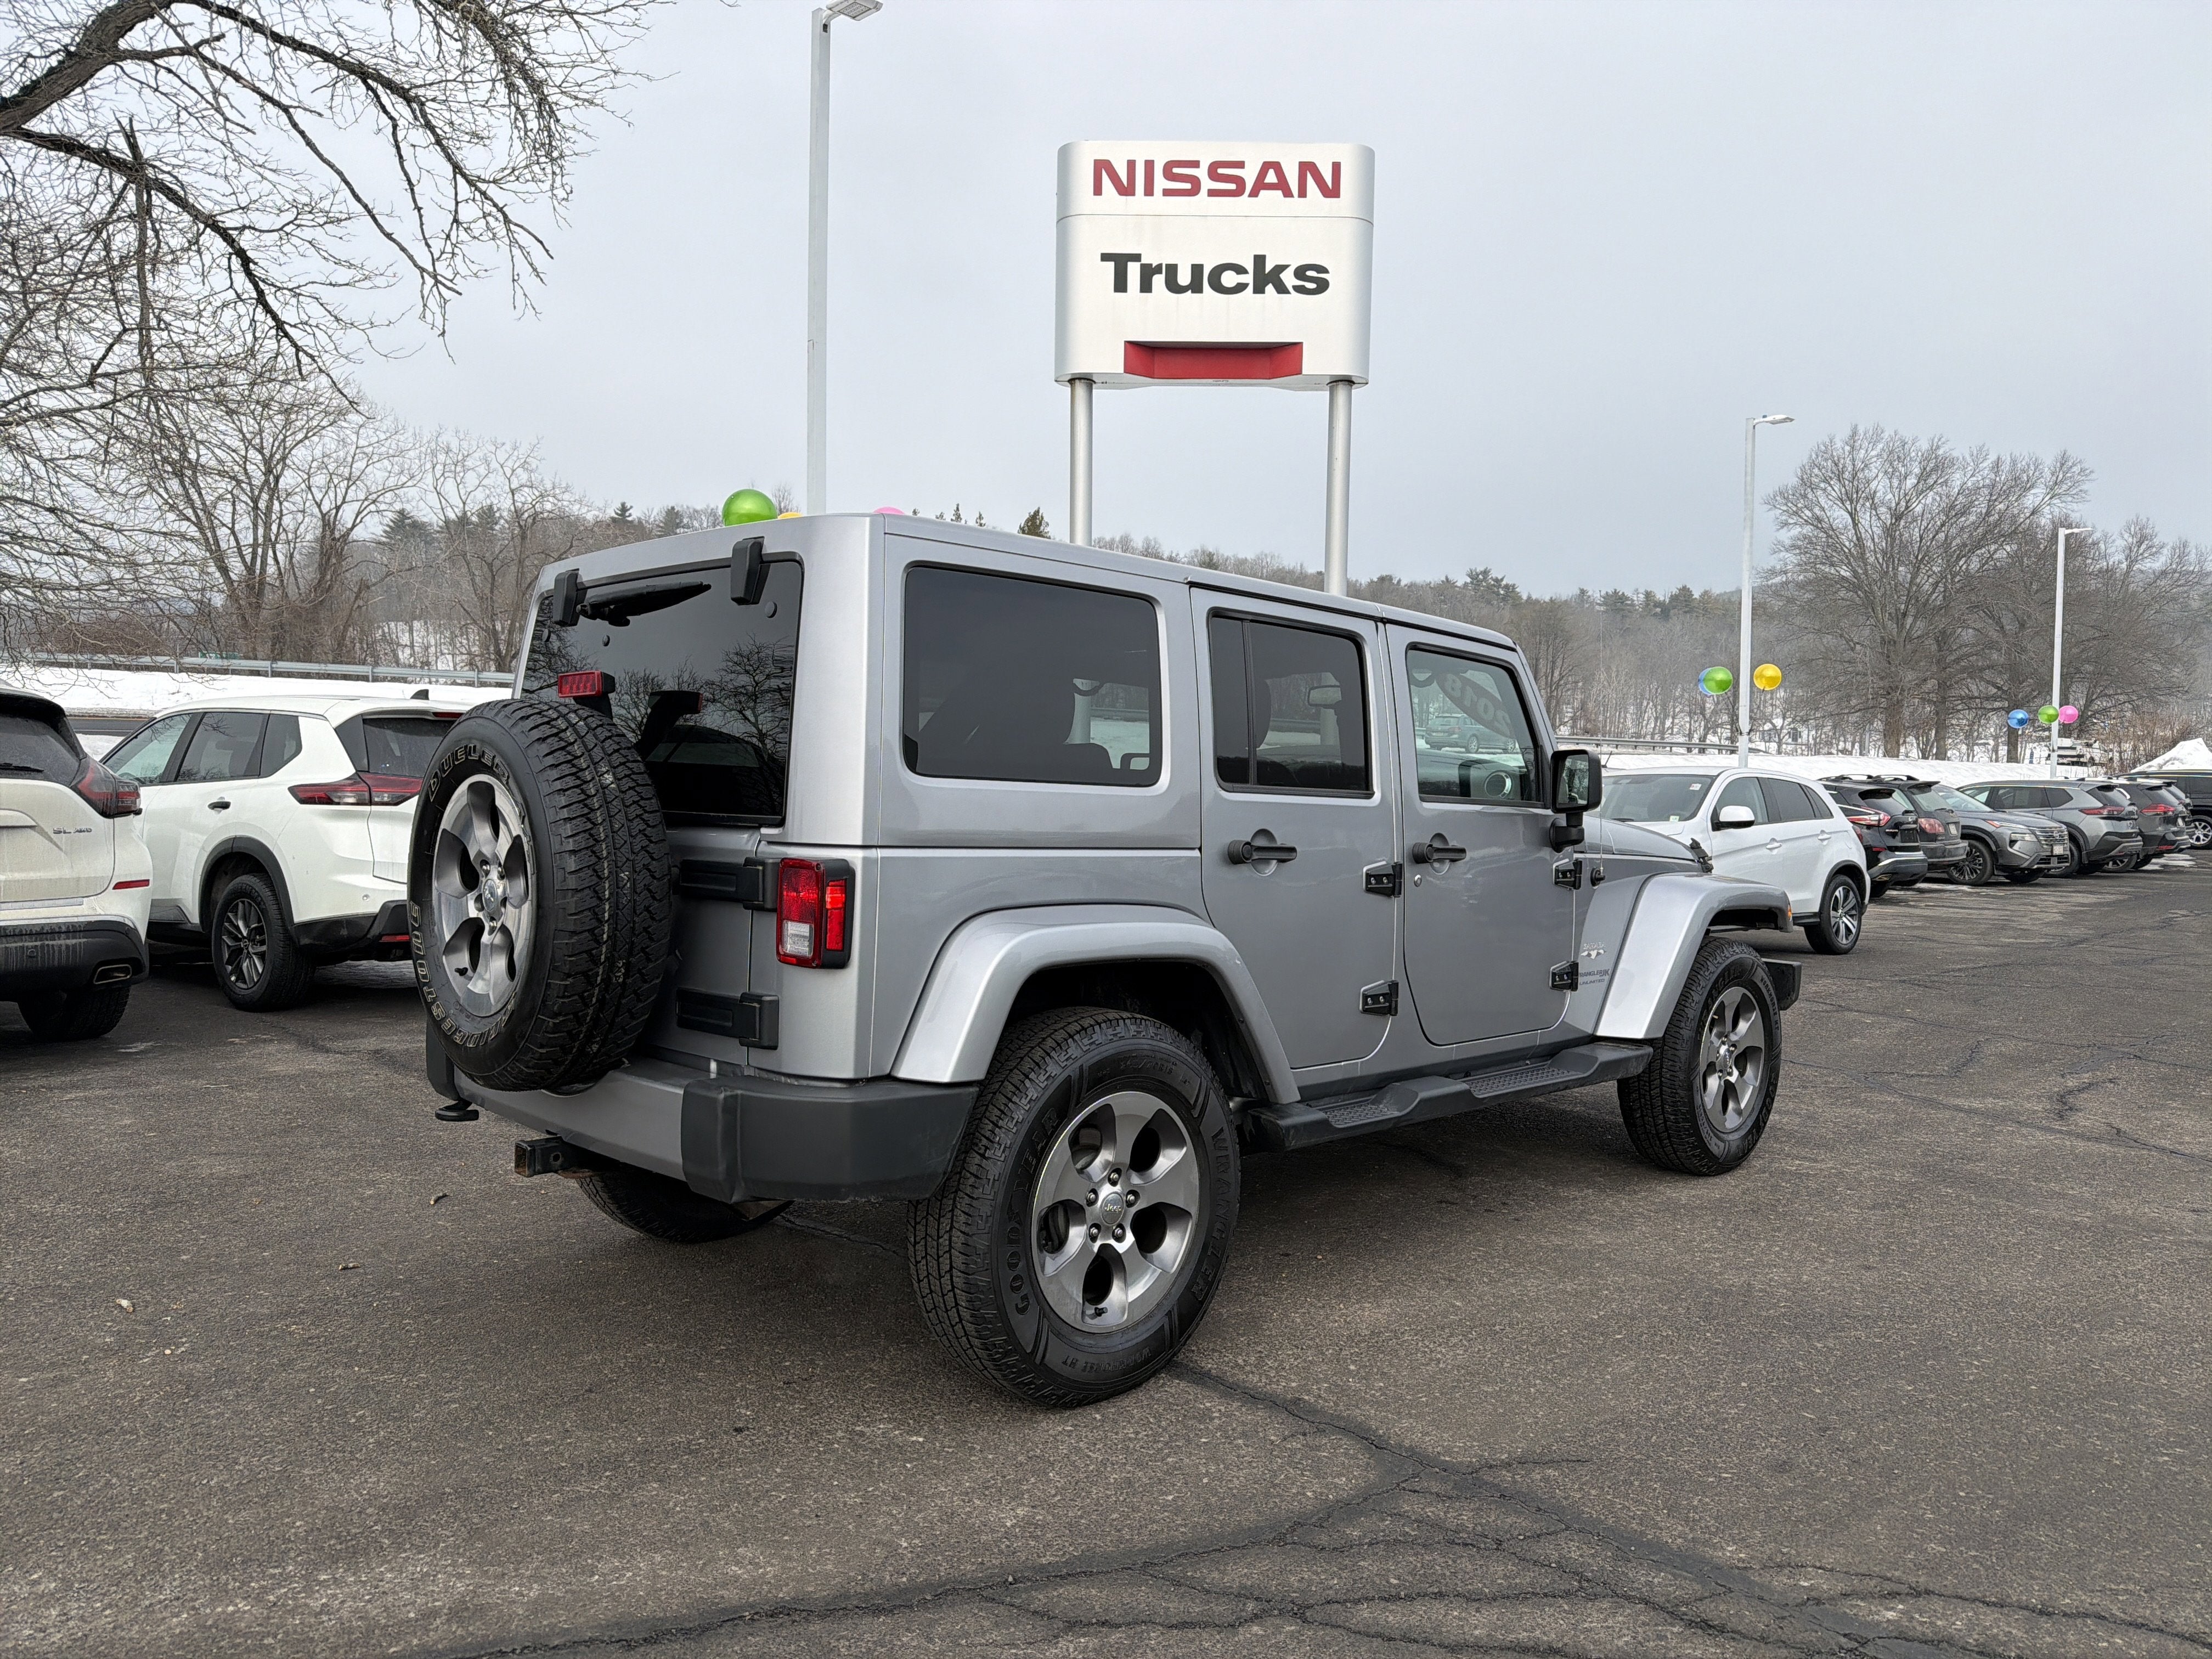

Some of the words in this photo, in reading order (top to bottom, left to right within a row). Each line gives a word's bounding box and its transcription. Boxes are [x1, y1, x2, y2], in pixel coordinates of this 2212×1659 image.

[1093, 159, 1341, 198] NISSAN
[1100, 252, 1330, 295] Trucks
[428, 743, 510, 803] DUELER
[1190, 1126, 1232, 1301] WRANGLER
